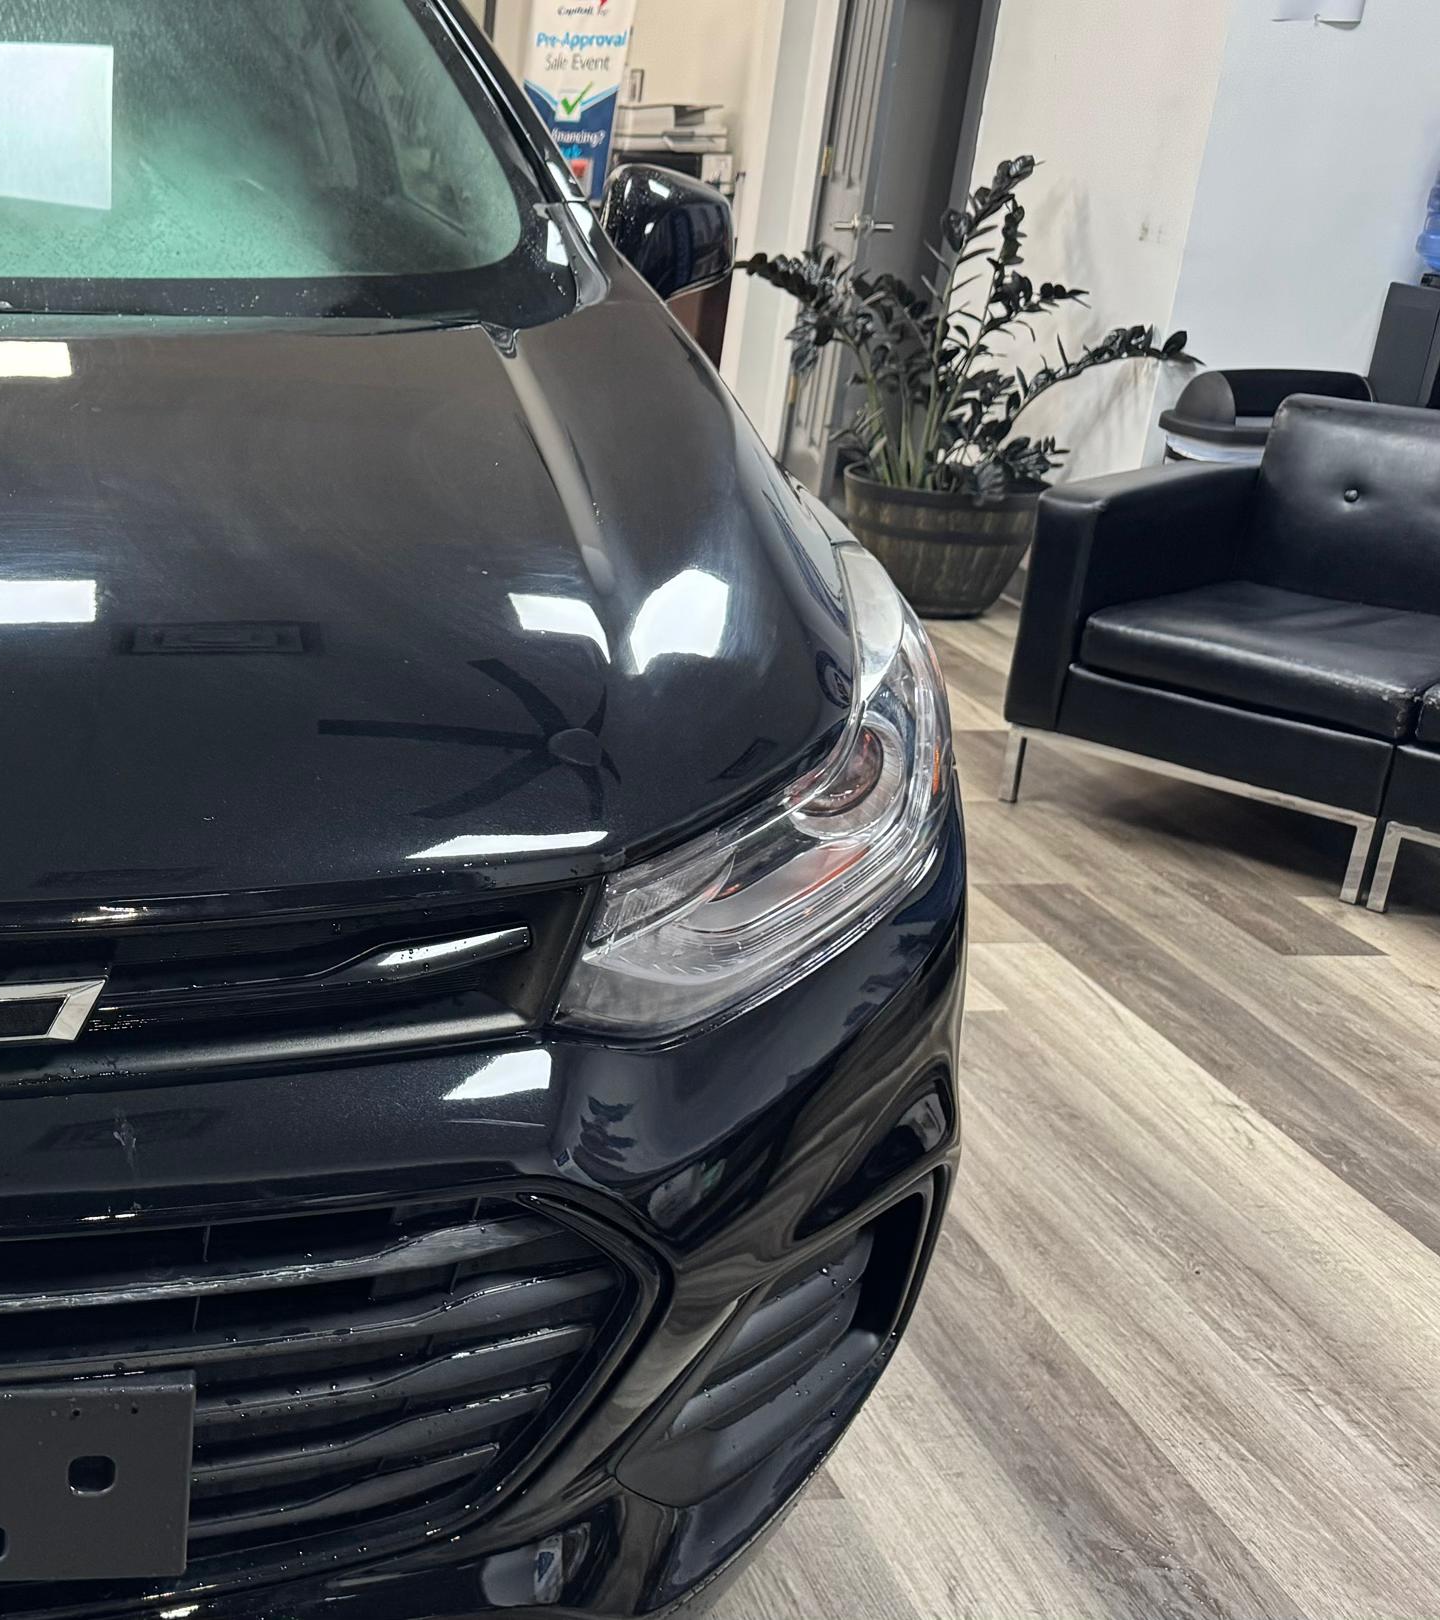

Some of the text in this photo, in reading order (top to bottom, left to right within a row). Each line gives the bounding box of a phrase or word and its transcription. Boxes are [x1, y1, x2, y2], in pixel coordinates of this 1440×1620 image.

[536, 30, 627, 50] Pre-Approval
[545, 53, 610, 71] Sale Event
